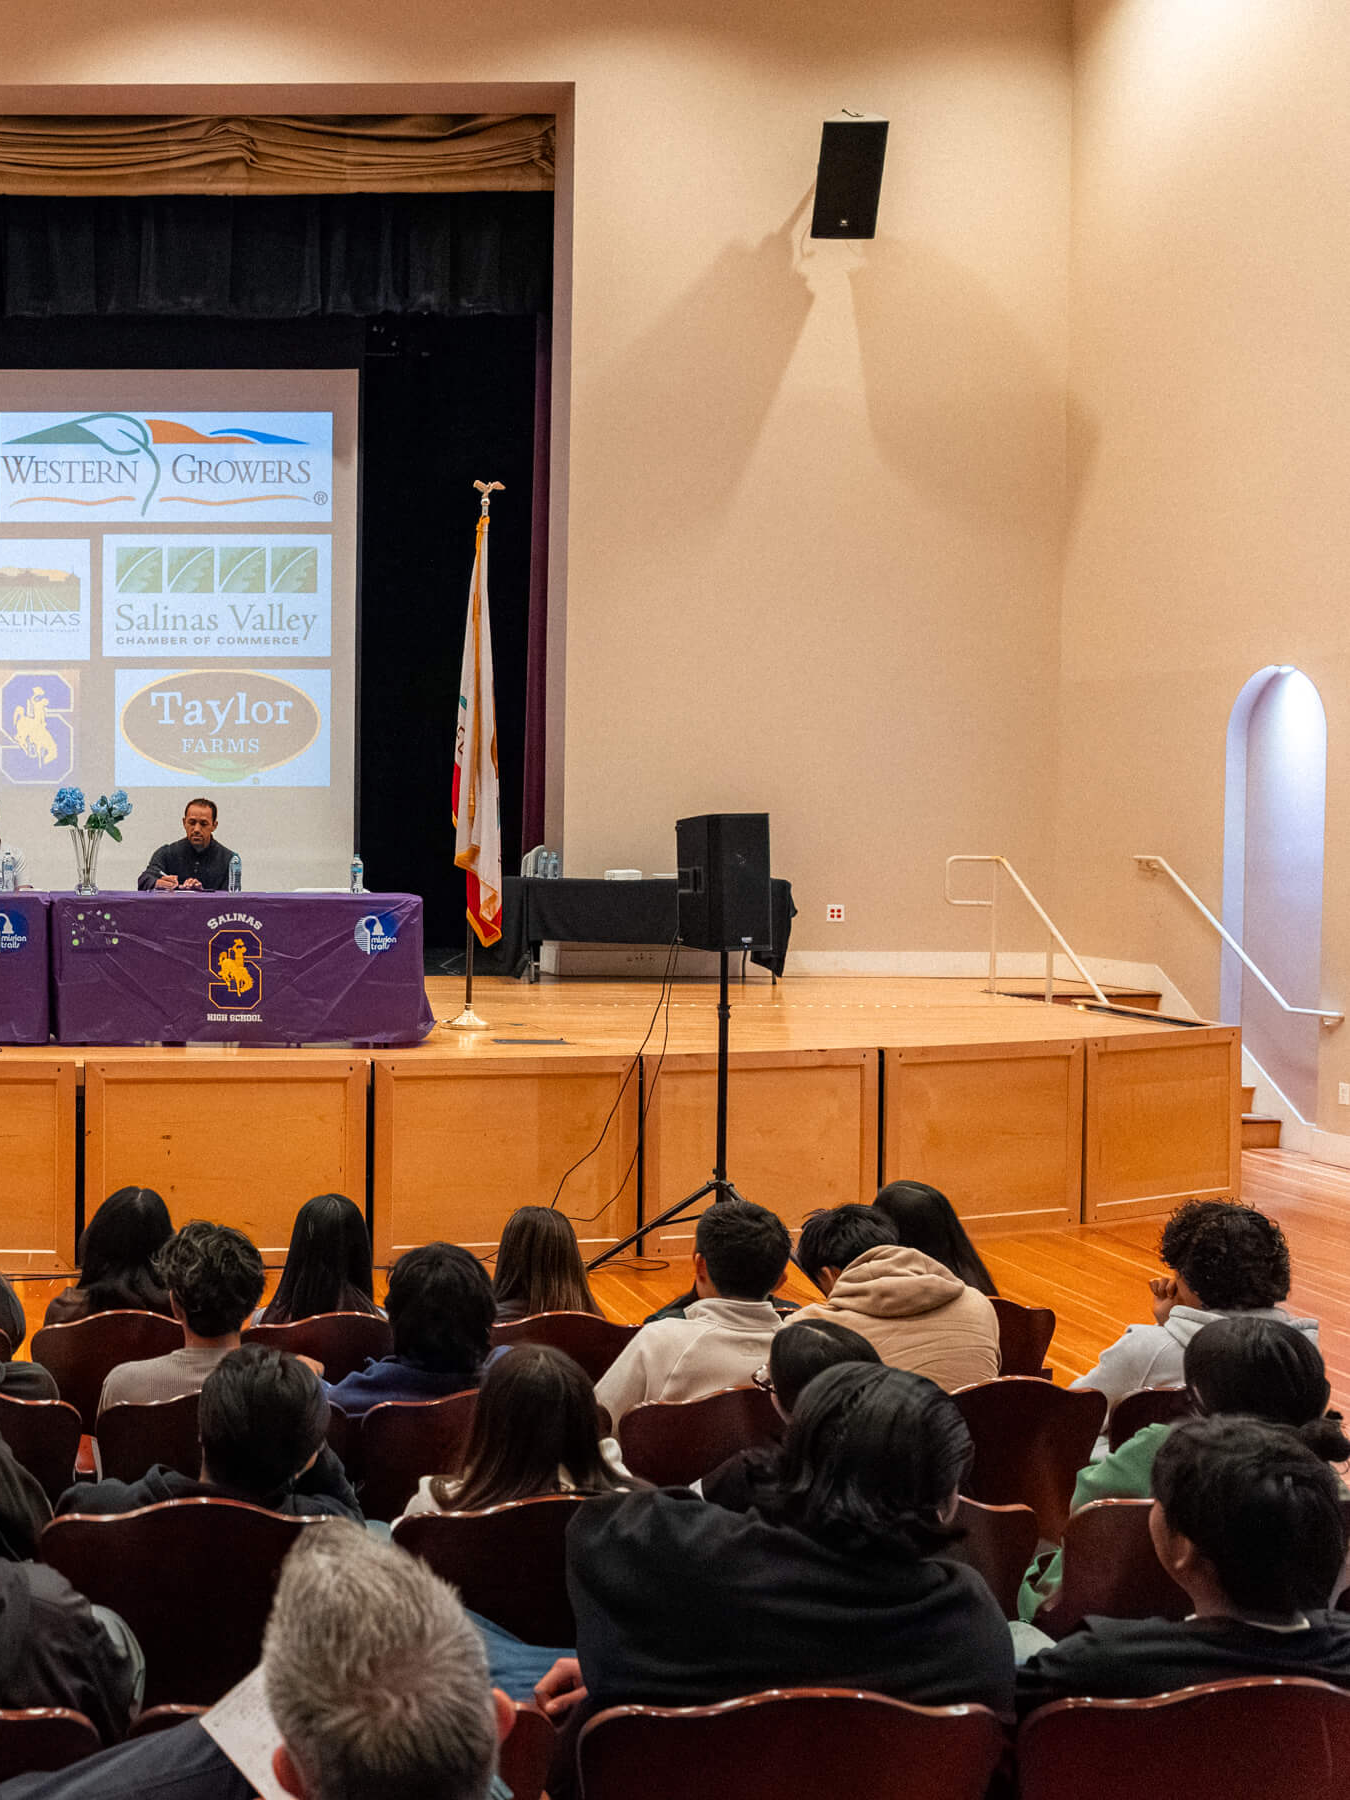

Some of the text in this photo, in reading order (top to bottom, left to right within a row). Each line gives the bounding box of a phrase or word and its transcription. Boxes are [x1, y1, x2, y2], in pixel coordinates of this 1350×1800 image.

[0, 453, 311, 485] WESTERN GROWERS
[115, 603, 318, 640] Salinas Valley
[116, 636, 299, 645] CHAMBER OF COMMERCE
[150, 691, 293, 735] Taylor
[182, 738, 261, 753] FARMS
[206, 912, 263, 931] SALINAS
[206, 1013, 263, 1023] HIGH SCHOOL
